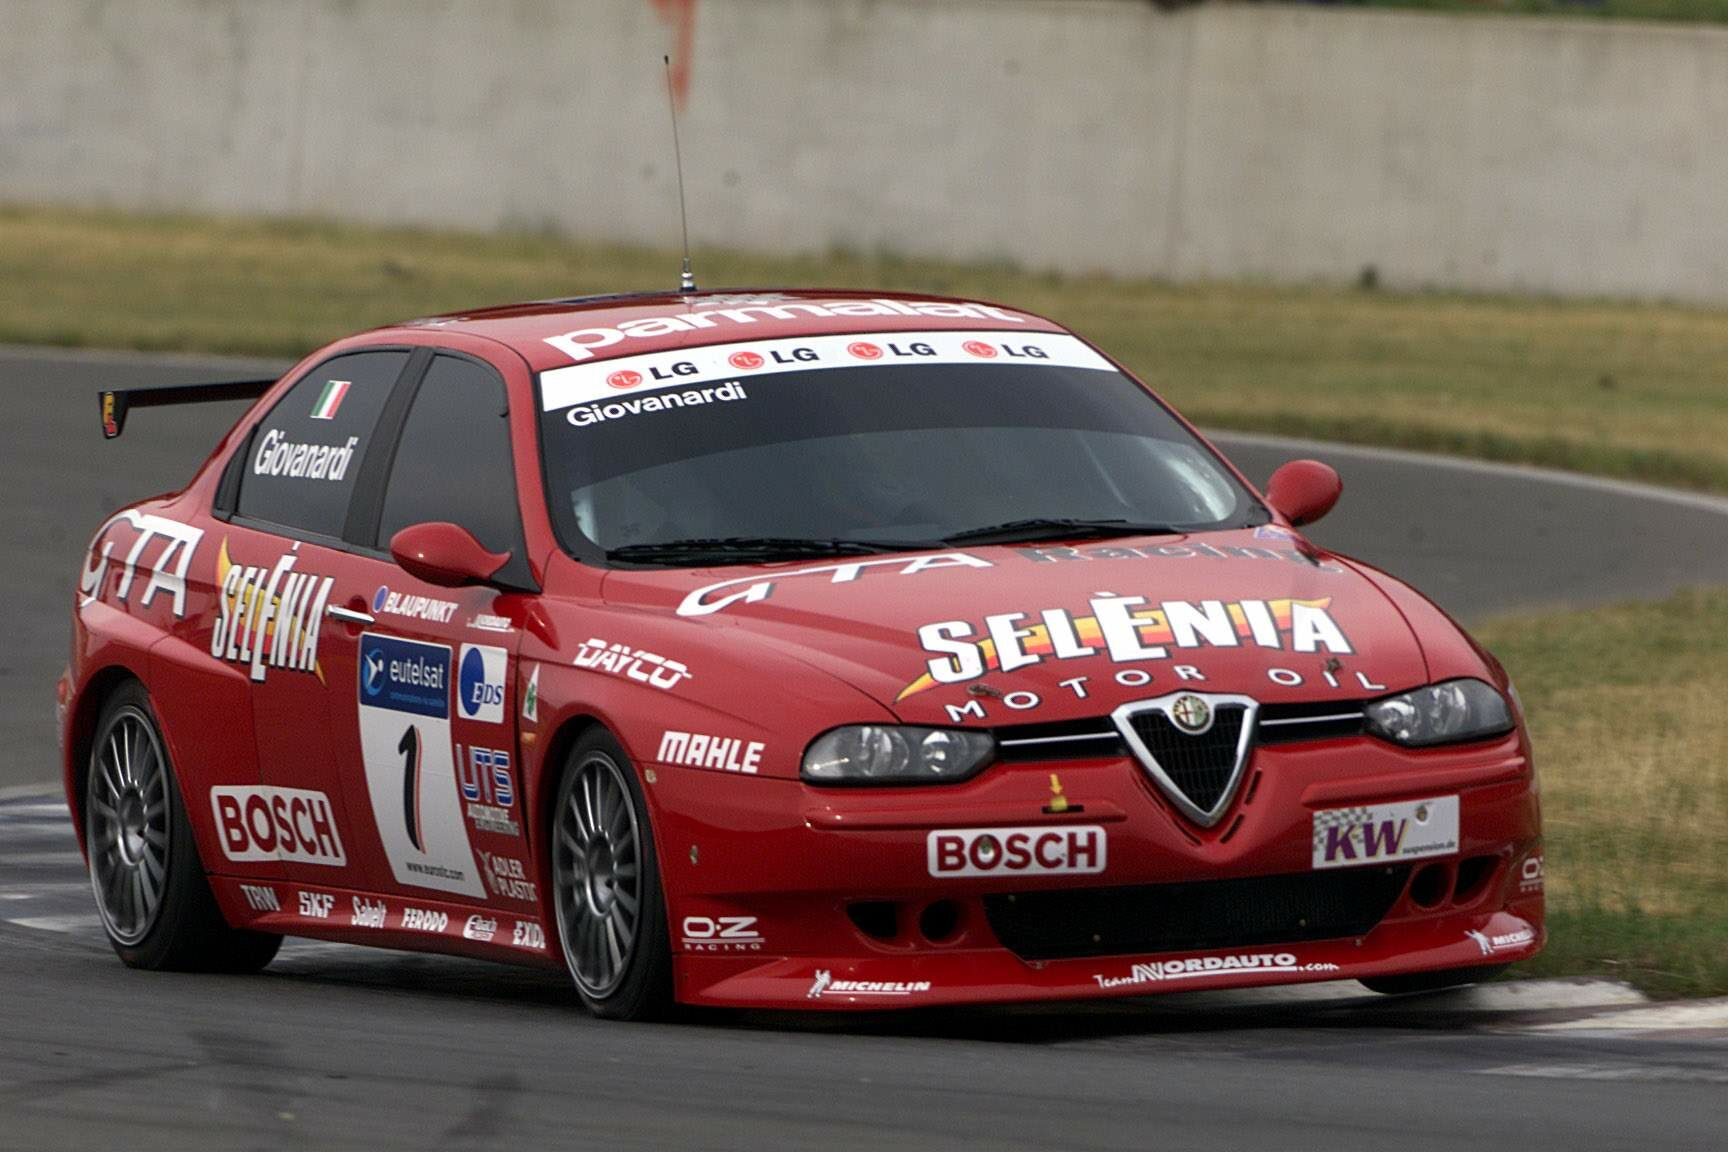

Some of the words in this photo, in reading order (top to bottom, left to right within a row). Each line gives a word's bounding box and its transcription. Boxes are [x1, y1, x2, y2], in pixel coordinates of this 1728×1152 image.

[543, 298, 1025, 360] parmalat
[649, 360, 700, 381] LG
[769, 346, 820, 364] LG
[889, 341, 937, 358] LG
[1005, 343, 1049, 360] LG
[566, 381, 748, 428] Giovanardi
[254, 429, 359, 481] Giovanardi
[80, 508, 204, 618] GTA
[676, 552, 994, 616] GTA
[383, 591, 459, 623] BLAUPUNKT
[390, 656, 444, 689] eutelsat
[573, 638, 693, 689] DAYCO
[472, 681, 504, 706] EDS
[944, 665, 1207, 723] MOTOR
[1268, 668, 1387, 691] OIL
[657, 730, 766, 774] MAHLE
[398, 724, 424, 853] 1
[217, 794, 341, 858] BOSCH
[1324, 819, 1407, 862] KW
[492, 855, 526, 880] ADLER
[936, 831, 1098, 872] BOSCH
[240, 884, 281, 911] TRW
[298, 890, 335, 918] SKF
[401, 907, 448, 933] FERODO
[684, 942, 761, 951] RACING
[829, 980, 932, 992] MICHELIN
